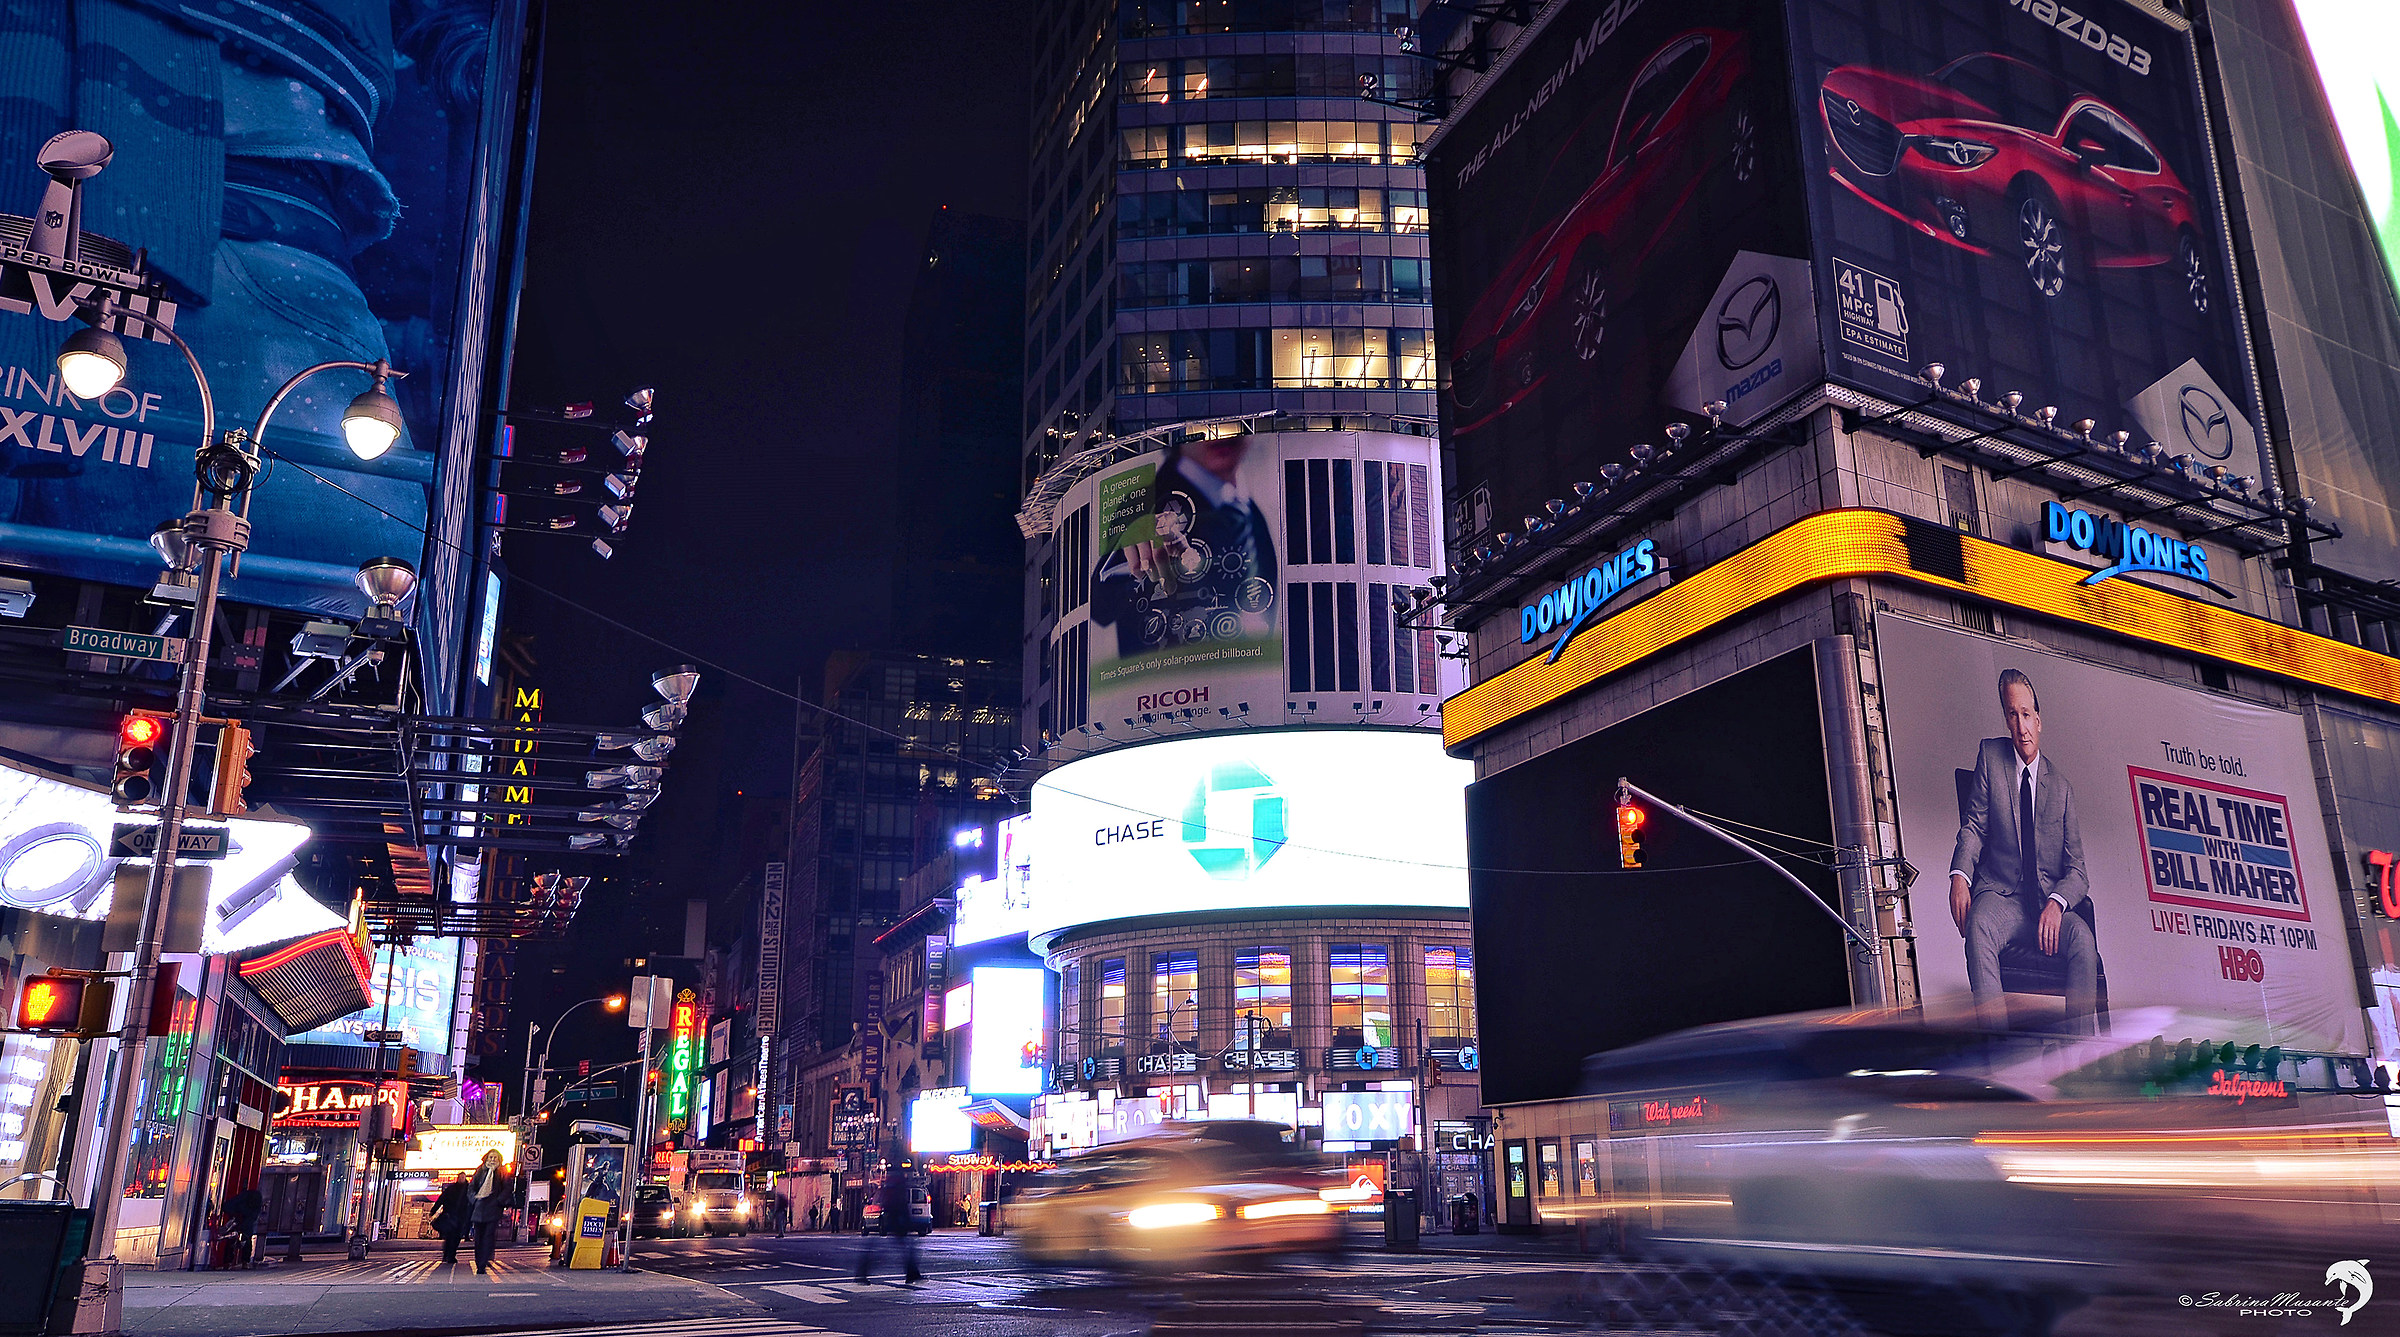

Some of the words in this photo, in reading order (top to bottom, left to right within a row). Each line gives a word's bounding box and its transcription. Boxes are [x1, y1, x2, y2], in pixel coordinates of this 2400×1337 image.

[1457, 145, 1487, 190] THE
[1489, 59, 1570, 158] ALL-NEW
[0, 248, 52, 269] PER
[62, 259, 127, 286] BOWL
[1840, 268, 1864, 298] 41
[1843, 309, 1875, 327] HIGHWAY
[1846, 328, 1862, 341] EPA
[1865, 335, 1903, 355] ESTIMATE
[100, 386, 162, 423] OF
[0, 406, 154, 469] XLVIII
[1102, 493, 1128, 512] planet,
[1130, 487, 1147, 500] one
[1103, 484, 1109, 495] A
[1110, 474, 1140, 495] greener
[1102, 505, 1134, 524] business
[1136, 502, 1145, 513] at
[1455, 500, 1468, 523] 41
[1102, 530, 1107, 539] a
[1108, 523, 1128, 536] time.
[69, 628, 158, 657] Broadway
[1100, 669, 1117, 681] Times
[1117, 660, 1145, 677] Square's
[1146, 657, 1162, 670] only
[1163, 649, 1220, 666] solar-powered
[1222, 645, 1263, 659] billboard.
[1137, 686, 1209, 711] RICOH
[2161, 740, 2196, 767] Truth
[2199, 748, 2217, 771] be
[2218, 754, 2247, 778] told.
[2140, 782, 2221, 837] REAL
[2217, 797, 2288, 848] TIME
[178, 834, 214, 850] WAY
[1095, 819, 1164, 847] CHASE
[2204, 837, 2241, 861] WITH
[767, 863, 783, 890] NEW
[2151, 850, 2209, 893] BILL
[2210, 858, 2300, 905] MAHER
[2151, 908, 2191, 935] LIVE!
[2193, 914, 2257, 945] FRIDAYS
[2260, 922, 2276, 945] AT
[2280, 925, 2318, 951] 10PM
[761, 937, 780, 990] STUDIOS
[927, 940, 944, 1010] VICTORY
[2217, 944, 2264, 984] HBO
[867, 974, 881, 1036] VICTORY
[926, 1021, 942, 1055] NEW
[671, 1006, 692, 1115] REGAL
[865, 1045, 878, 1076] NEW
[1138, 1053, 1197, 1073] CHASE
[1224, 1050, 1297, 1069] CHASE
[2206, 1068, 2289, 1106] Walgreens
[594, 1124, 613, 1132] Phone
